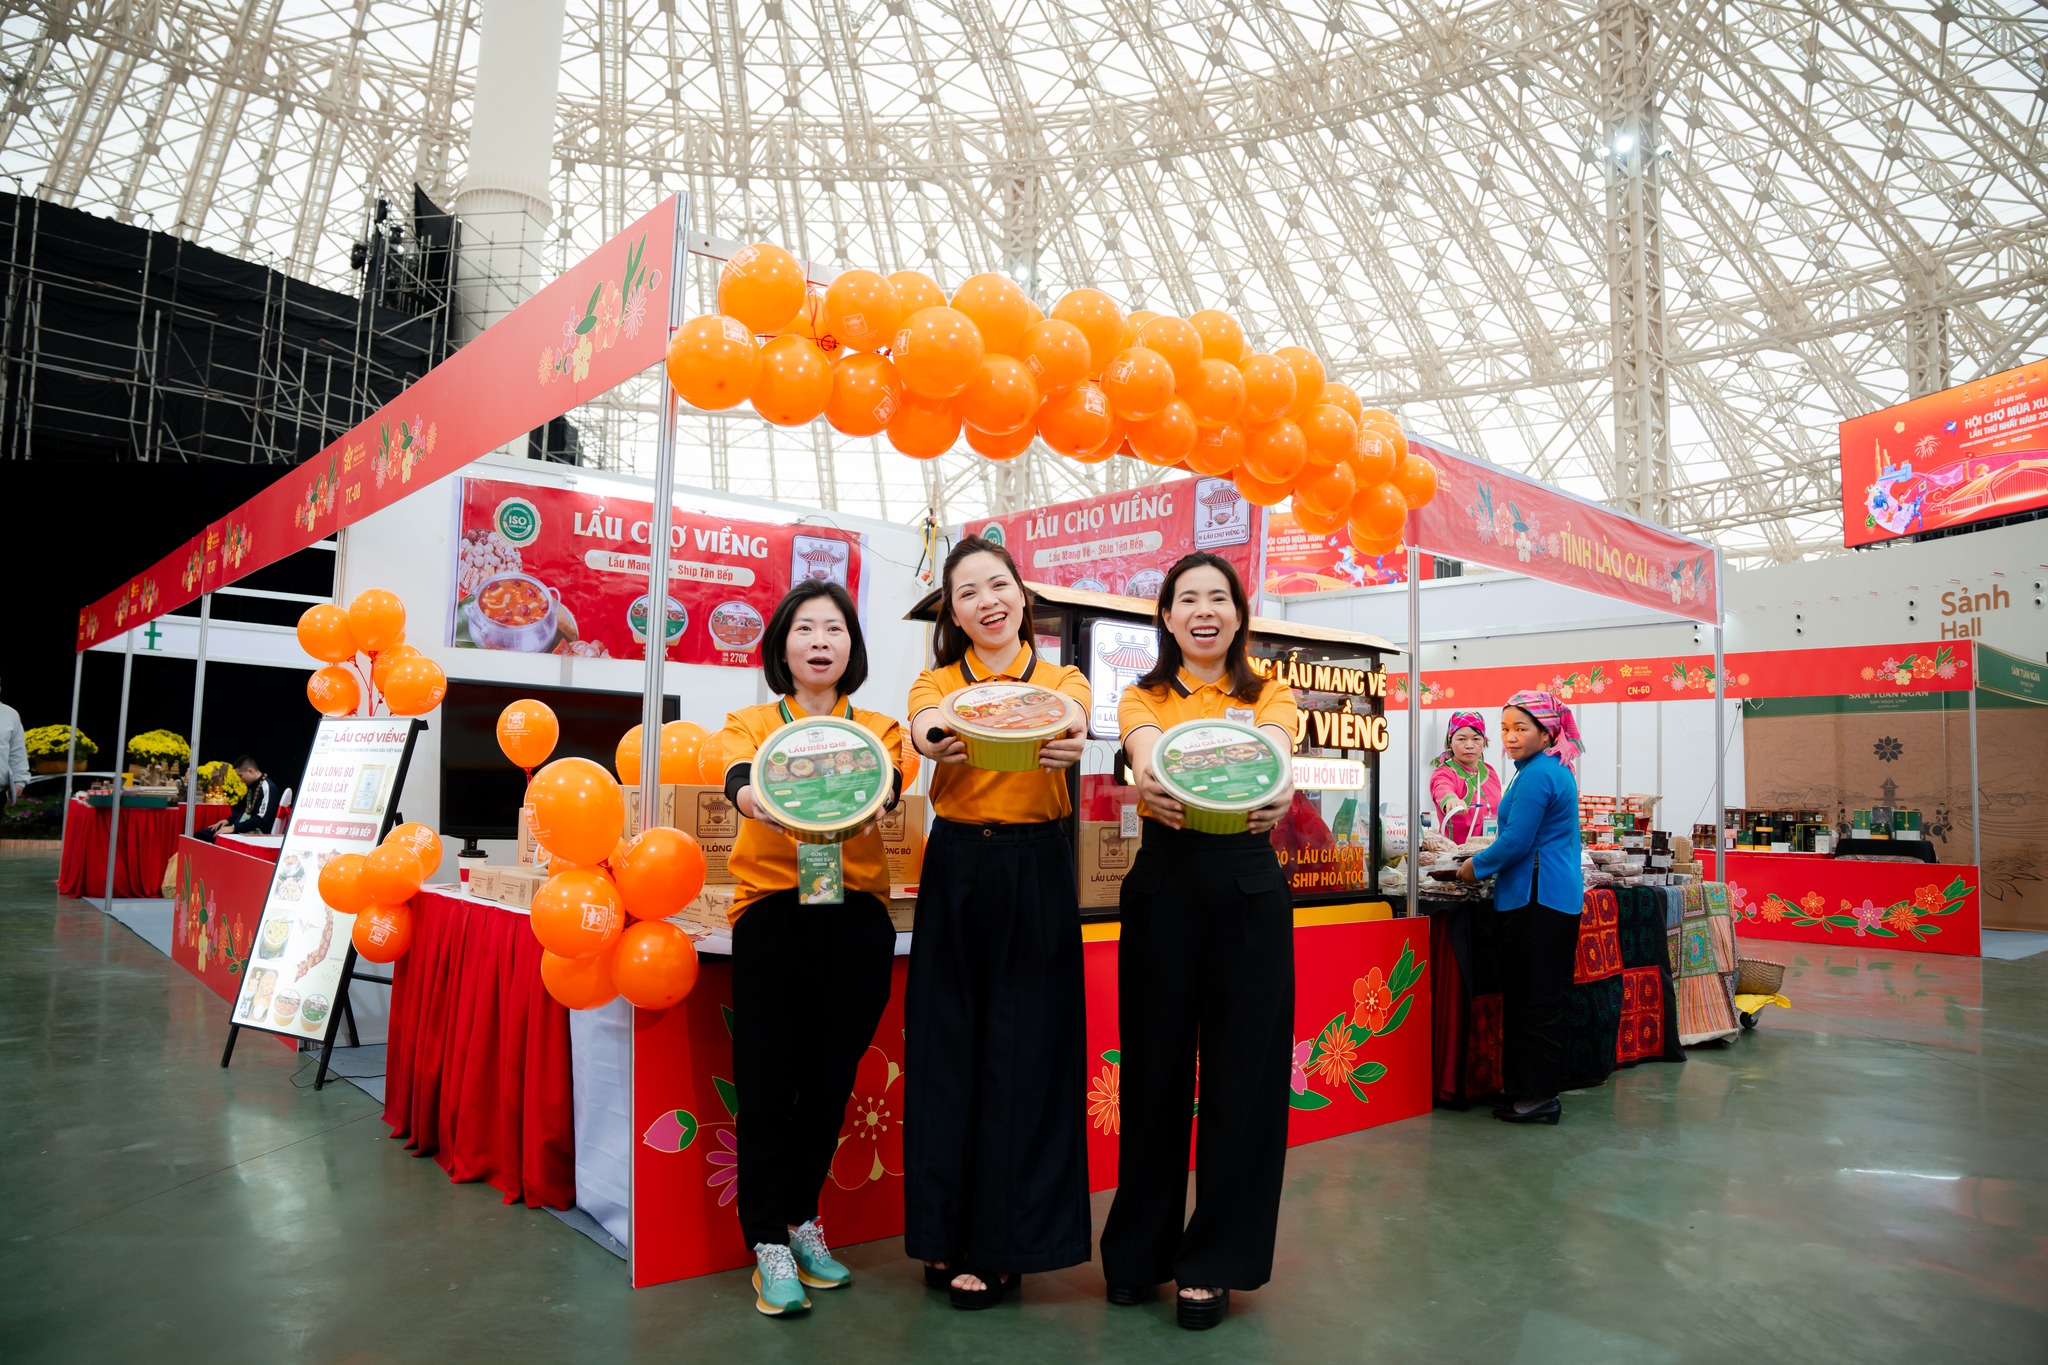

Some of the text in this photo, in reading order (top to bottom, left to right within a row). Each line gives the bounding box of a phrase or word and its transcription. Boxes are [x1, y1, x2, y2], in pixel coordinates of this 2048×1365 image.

[1965, 397, 2048, 429] HỘI CHỢ MÙA XU
[1969, 428, 1983, 439] LẦN
[1999, 417, 2018, 431] NHẤT
[2019, 413, 2037, 425] NĂM
[509, 515, 527, 526] ISO
[1026, 492, 1173, 541] LẨU CHỢ VIỀNG
[573, 506, 768, 558] LẨU CỢ VIỀNG
[1062, 550, 1080, 561] Mang
[1082, 545, 1091, 558] Về
[1098, 544, 1114, 555] Ship
[1130, 536, 1144, 550] Bếp
[1560, 521, 1648, 586] TỈNH LÀO CAI
[608, 555, 625, 569] Lẩu
[677, 565, 697, 577] Ship
[700, 567, 715, 581] Tận
[717, 569, 733, 582] Bếp
[1941, 584, 2010, 616] Sảnh
[1941, 617, 1982, 640] Hall
[730, 652, 748, 664] 270K
[1276, 651, 1313, 688] LẨU
[1314, 664, 1365, 695] MANG
[1367, 663, 1387, 697] VỀ
[1627, 685, 1651, 695] CN-60
[334, 727, 406, 744] LẨU CHỢ VIỀNG
[1312, 698, 1389, 751] VIỀNG
[788, 741, 847, 754] LẨU RIÊU GHẸ
[1184, 742, 1200, 750] LẨU
[1313, 761, 1336, 785] HỒN
[1339, 764, 1359, 787] VIỆT
[335, 827, 349, 835] SHIP
[706, 842, 732, 852] LÒNG
[885, 845, 911, 855] ÒNG BÒ
[1297, 842, 1318, 865] LẨU
[1091, 871, 1105, 882] LẨU
[1293, 872, 1319, 888] SHIP
[1345, 864, 1364, 884] TỐC
